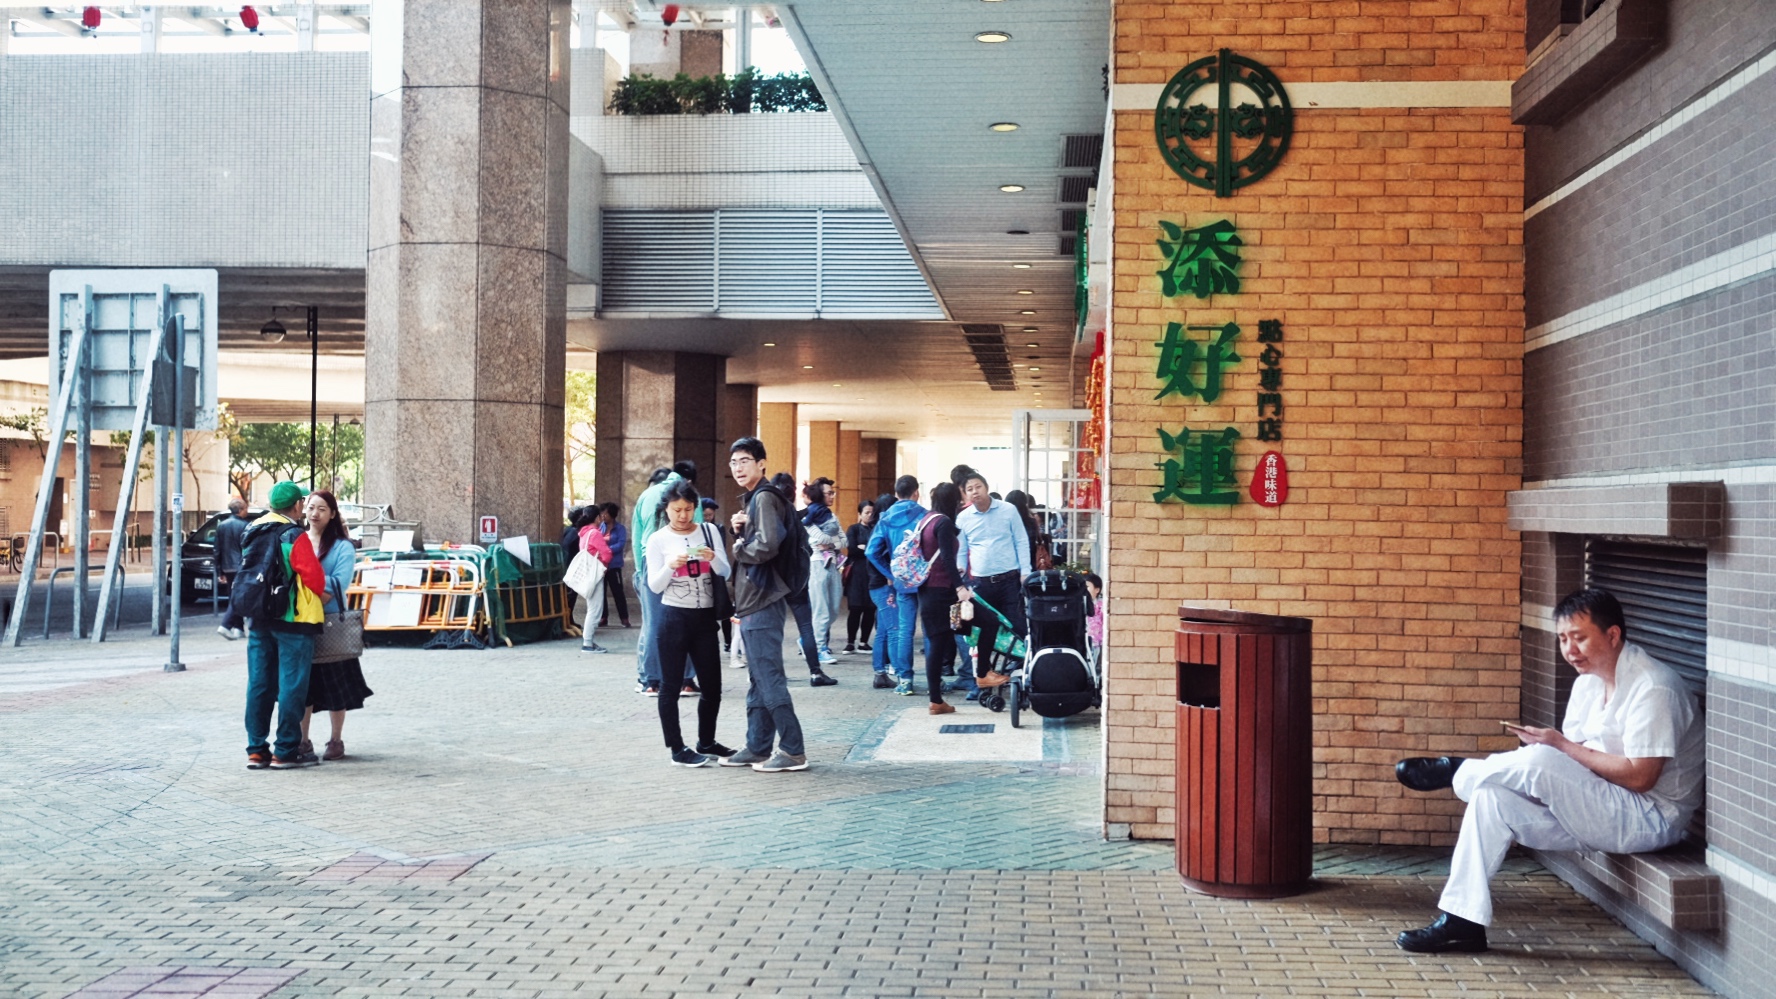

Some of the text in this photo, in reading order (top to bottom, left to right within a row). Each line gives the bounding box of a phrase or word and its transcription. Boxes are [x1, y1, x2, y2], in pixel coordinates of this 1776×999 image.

[1153, 219, 1242, 504] 添好運
[1257, 319, 1283, 442] 點心專門店
[1265, 454, 1278, 503] 香港味道
